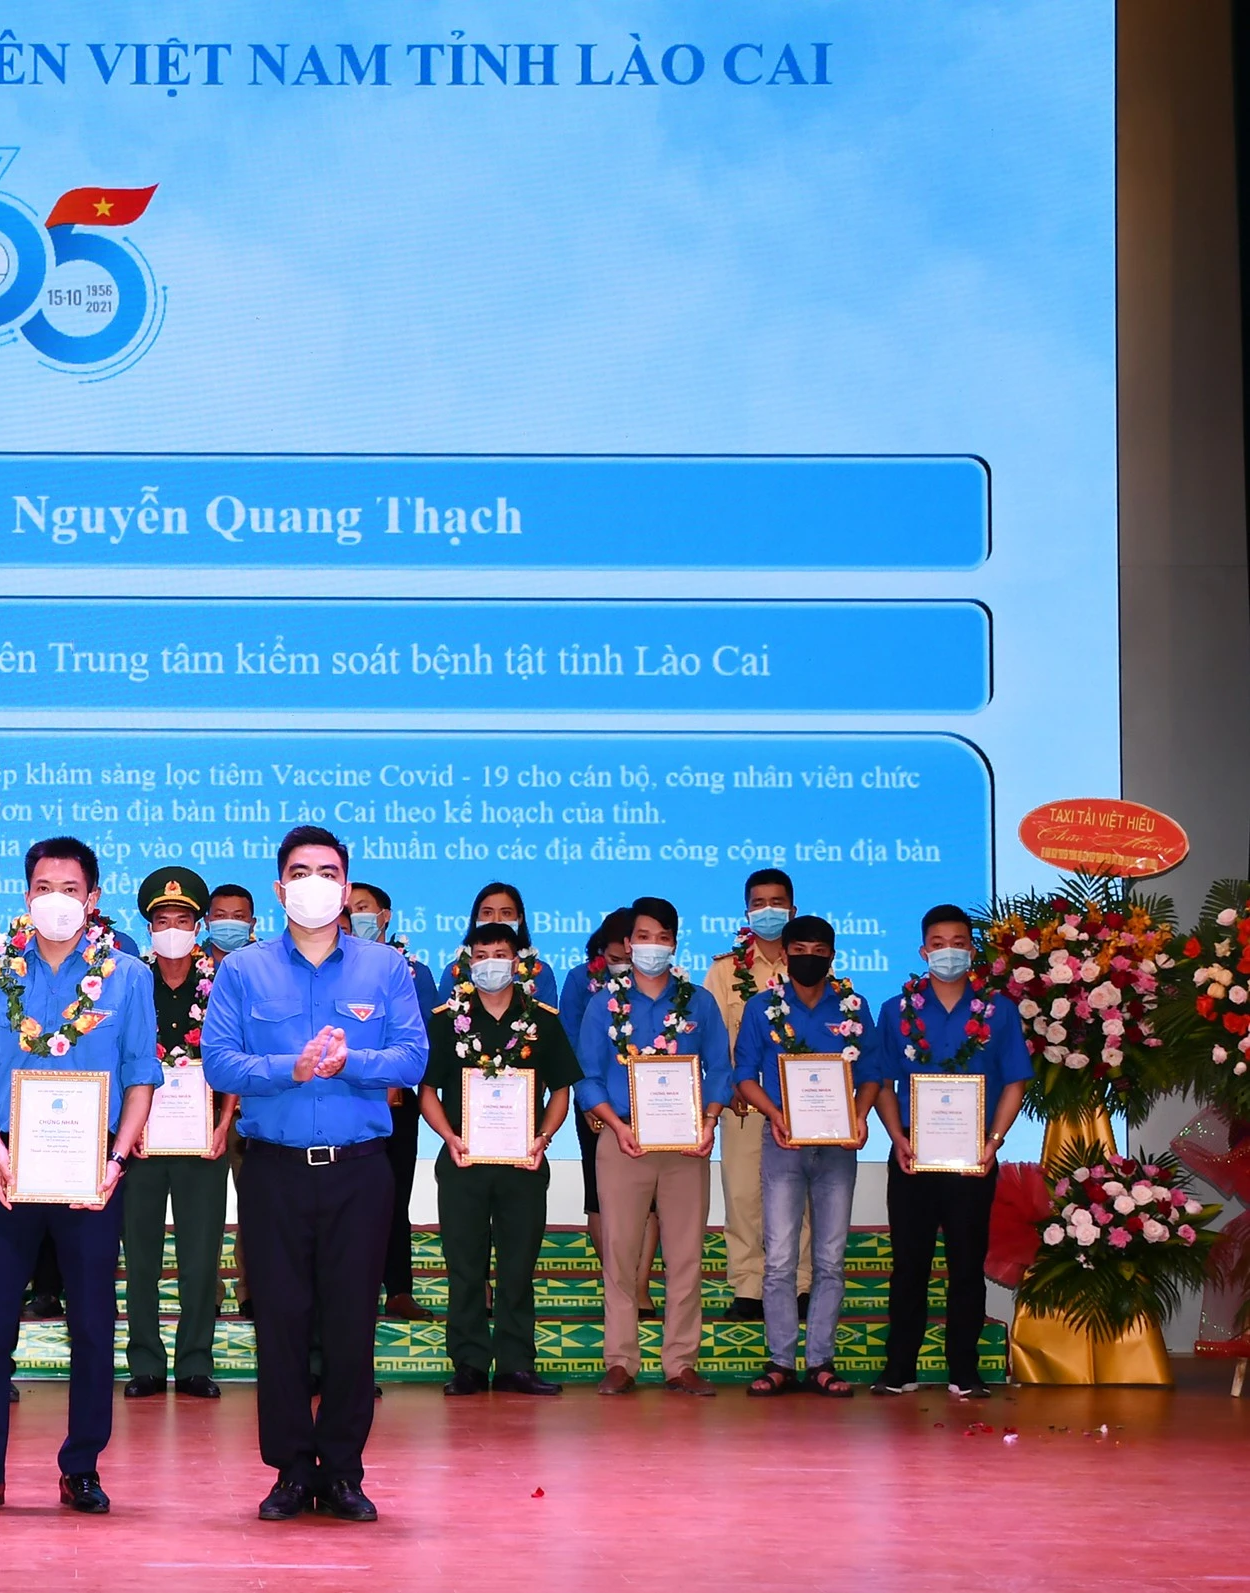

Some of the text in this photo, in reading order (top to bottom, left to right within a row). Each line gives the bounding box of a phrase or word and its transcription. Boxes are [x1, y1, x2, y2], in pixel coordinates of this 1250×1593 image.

[87, 37, 232, 97] VIỆT
[248, 43, 391, 86] NAM
[407, 30, 560, 86] TỈNH
[576, 33, 705, 86] LÀO
[723, 42, 833, 86] CAI
[86, 285, 112, 297] 1956
[86, 301, 112, 313] 2021
[12, 486, 189, 544] Nguyễn
[206, 495, 362, 546] Quang
[376, 497, 522, 546] Thạch
[48, 642, 149, 682] Trung
[162, 642, 224, 674] tâm
[235, 635, 319, 674] kiểm
[332, 643, 399, 675] soát
[411, 643, 492, 680] bệnh
[505, 643, 547, 680] tật
[558, 643, 624, 675] tỉnh
[634, 644, 701, 676] Lào
[712, 644, 771, 676] Cai
[26, 763, 93, 786] khám
[101, 766, 156, 791] sàng
[166, 763, 200, 790] lọc
[210, 763, 263, 787] tiêm
[272, 764, 371, 787] Vaccine
[380, 764, 454, 787] Covid
[482, 765, 508, 787] 19
[517, 765, 561, 787] cho
[569, 765, 612, 788] cán
[666, 765, 725, 794] công
[733, 765, 793, 789] nhân
[801, 765, 854, 789] viên
[861, 765, 920, 789] chức
[40, 802, 63, 826] vị
[72, 799, 119, 822] trên
[126, 800, 164, 827] địa
[172, 799, 216, 822] bàn
[224, 799, 270, 823] tỉnh
[279, 801, 326, 823] Lào
[334, 801, 376, 823] Cai
[384, 800, 436, 823] theo
[444, 794, 472, 823] kế
[481, 800, 554, 828] hoạch
[562, 801, 604, 824] của
[612, 800, 667, 824] tỉnh.
[1049, 806, 1156, 833] TAXI TẢI VIỆT HIẾU
[140, 836, 183, 859] vào
[191, 836, 234, 865] quá
[362, 831, 437, 861] khuẩn
[445, 837, 489, 860] cho
[497, 838, 538, 860] các
[546, 837, 583, 865] địa
[591, 832, 651, 861] điểm
[660, 839, 719, 867] công
[727, 839, 787, 868] cộng
[795, 839, 842, 861] trên
[850, 839, 888, 866] địa
[896, 839, 941, 862] bàn
[397, 906, 427, 933] hỗ
[533, 911, 591, 934] Bình
[813, 911, 887, 937] hám,
